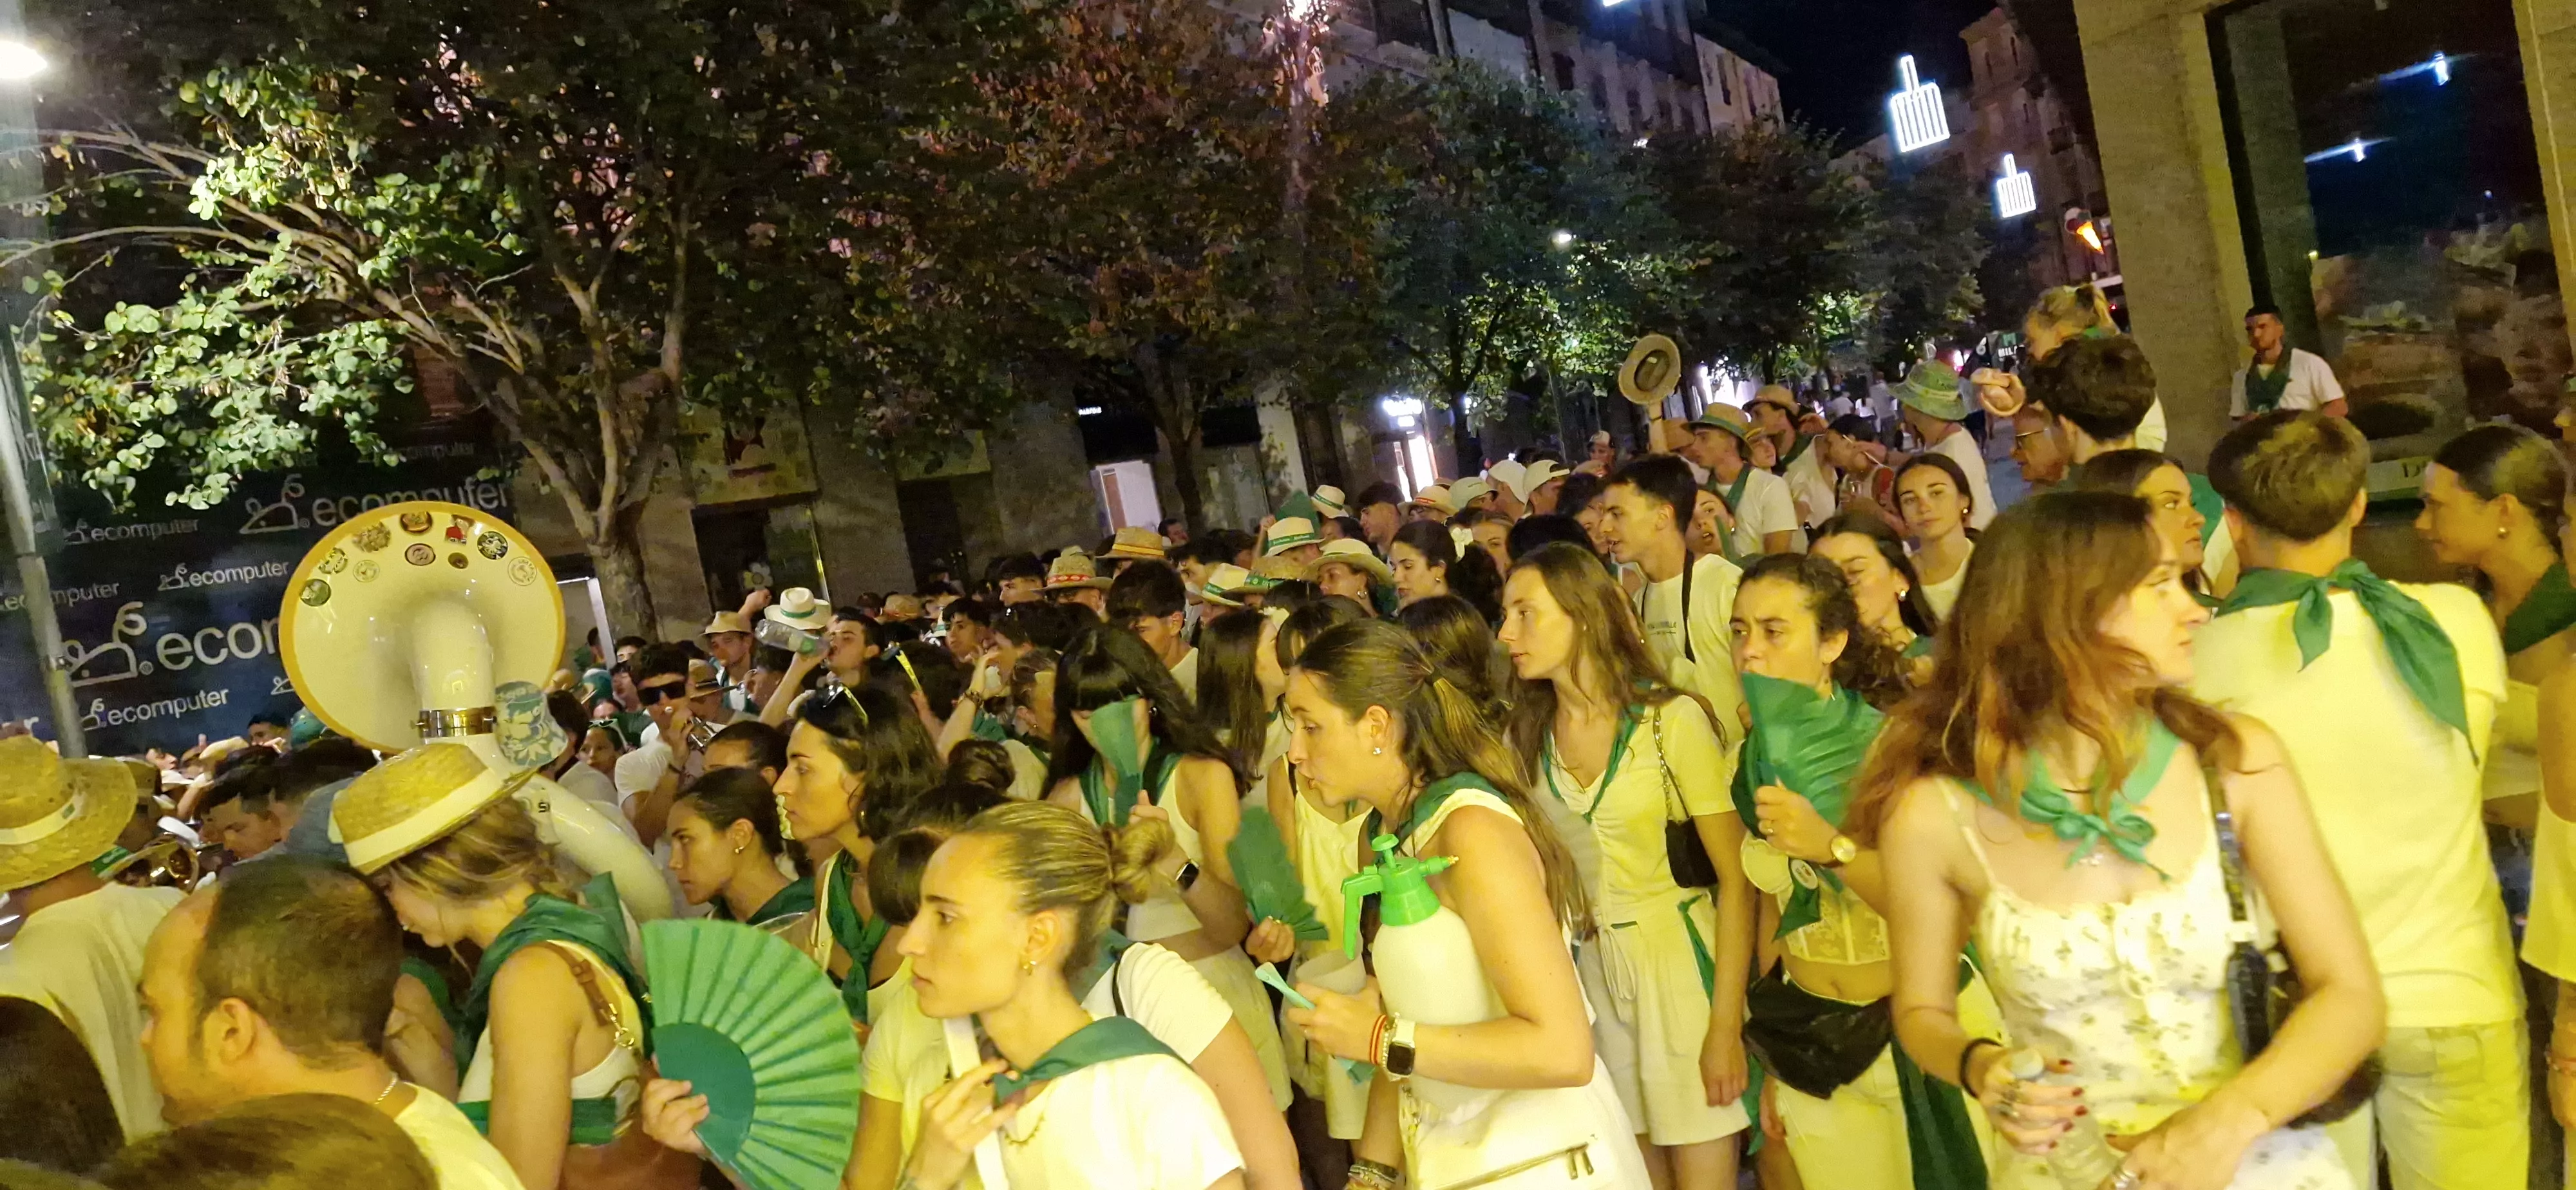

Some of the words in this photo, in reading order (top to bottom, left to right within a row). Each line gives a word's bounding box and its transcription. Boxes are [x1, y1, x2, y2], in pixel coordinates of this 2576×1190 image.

[91, 518, 200, 540] ecomputer
[189, 561, 289, 587] ecomputer
[108, 688, 229, 725] ecomputer
